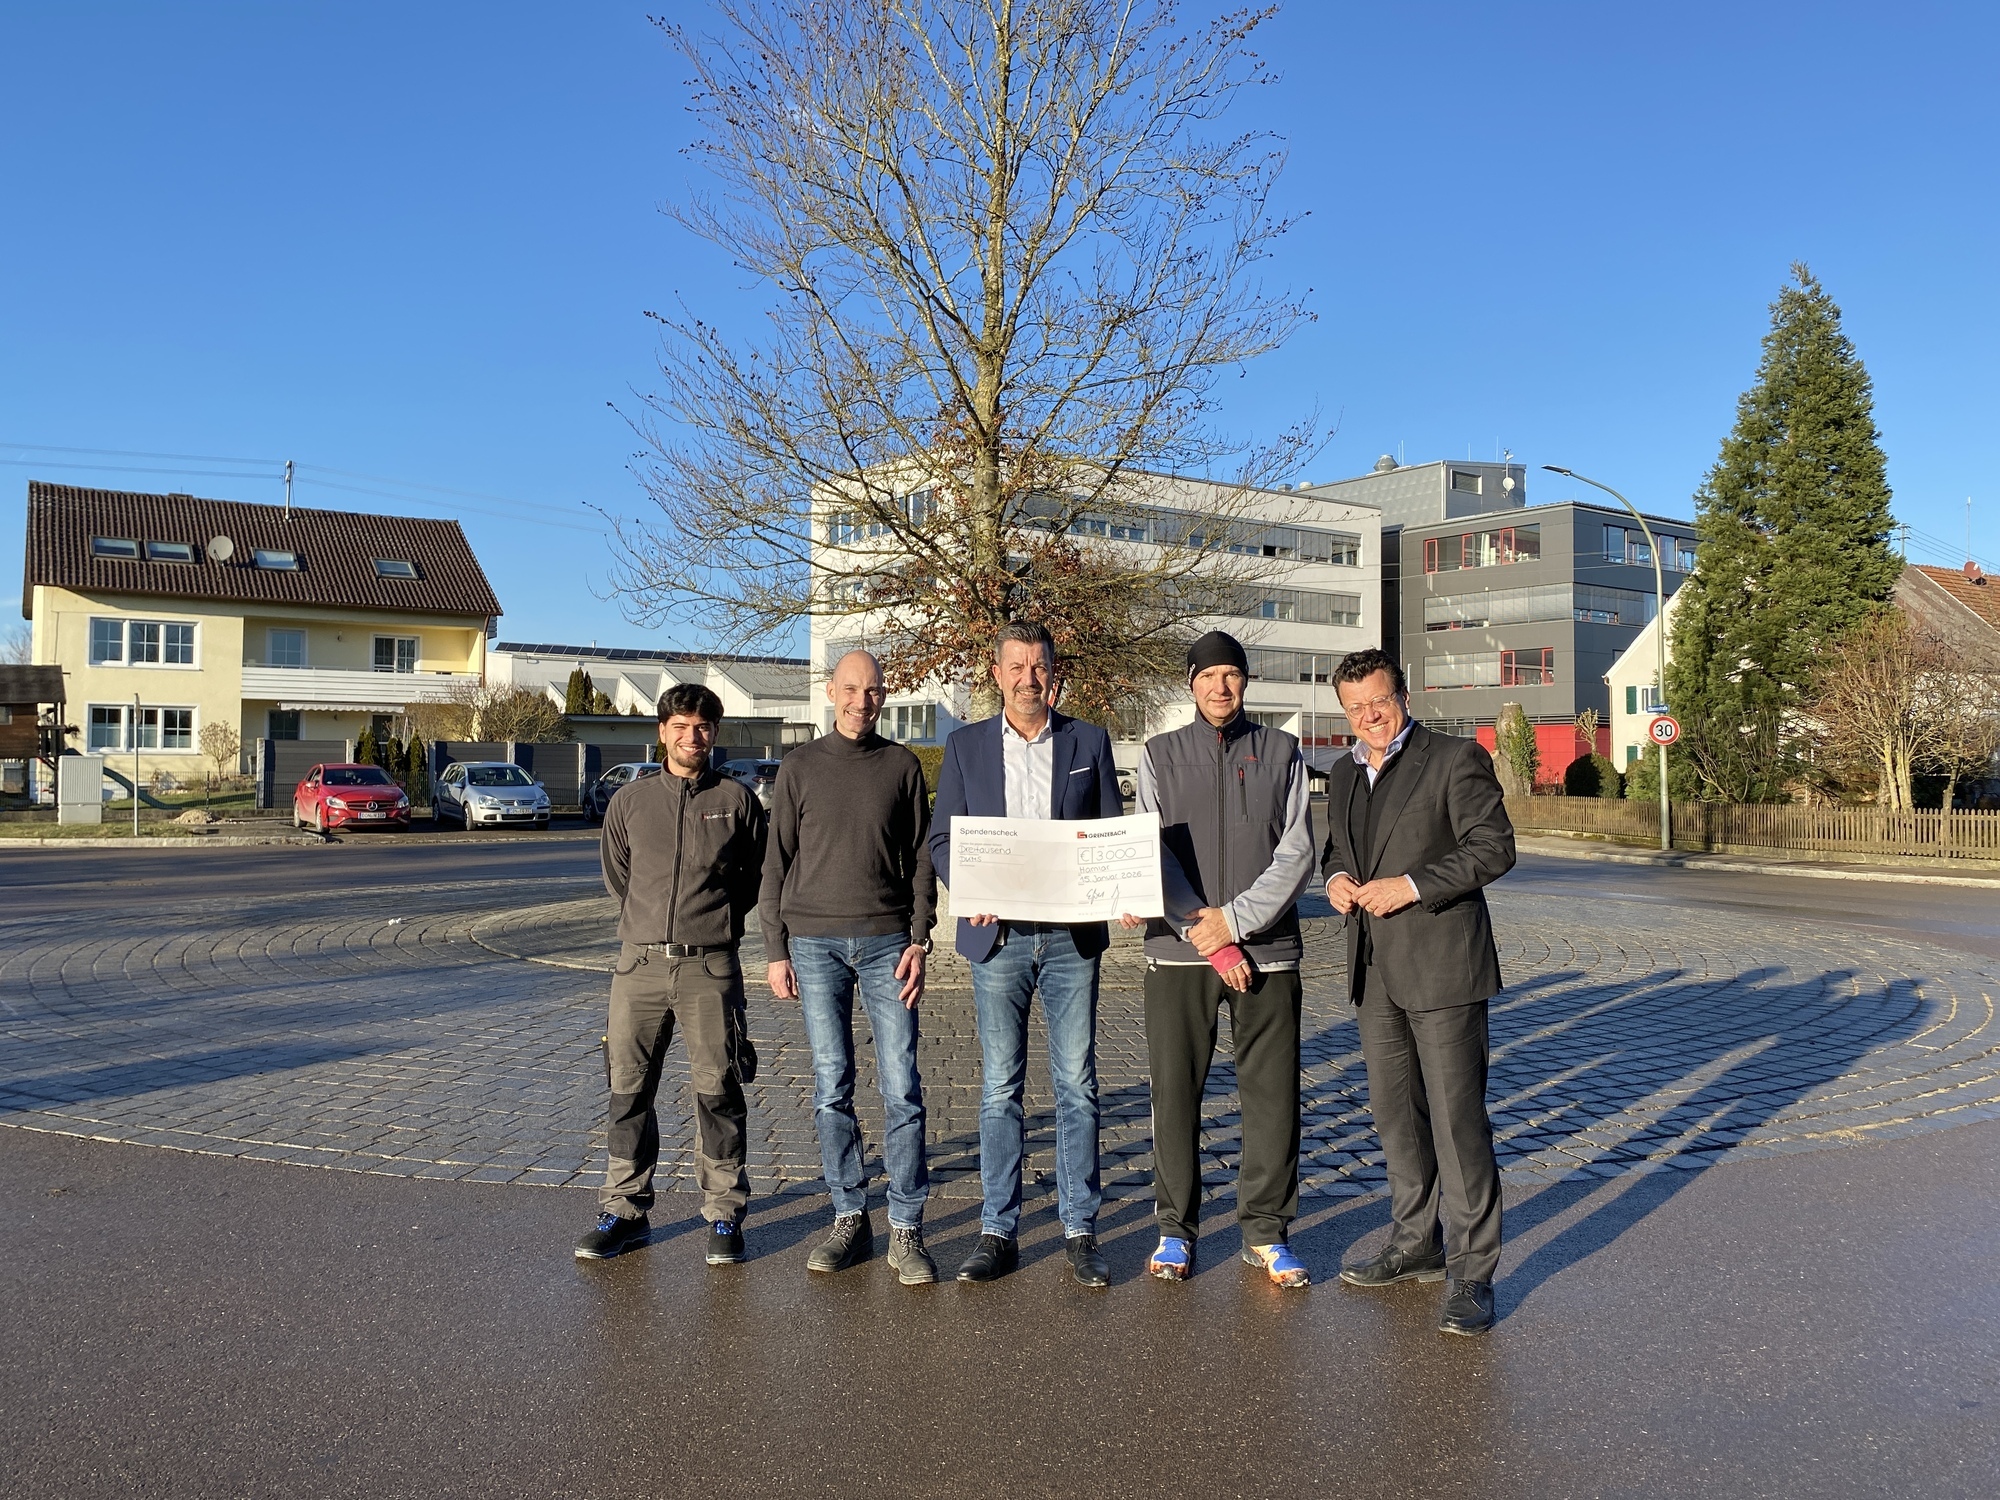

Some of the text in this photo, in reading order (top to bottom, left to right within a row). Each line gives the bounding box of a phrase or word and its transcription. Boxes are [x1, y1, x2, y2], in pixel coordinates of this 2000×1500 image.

[1655, 724, 1673, 737] 30
[960, 827, 1018, 837] Spendenscheck
[1088, 830, 1127, 838] GRENZEBACH
[958, 845, 1012, 855] Dreitausend
[1096, 847, 1137, 862] 3000
[1121, 870, 1142, 879] 2026
